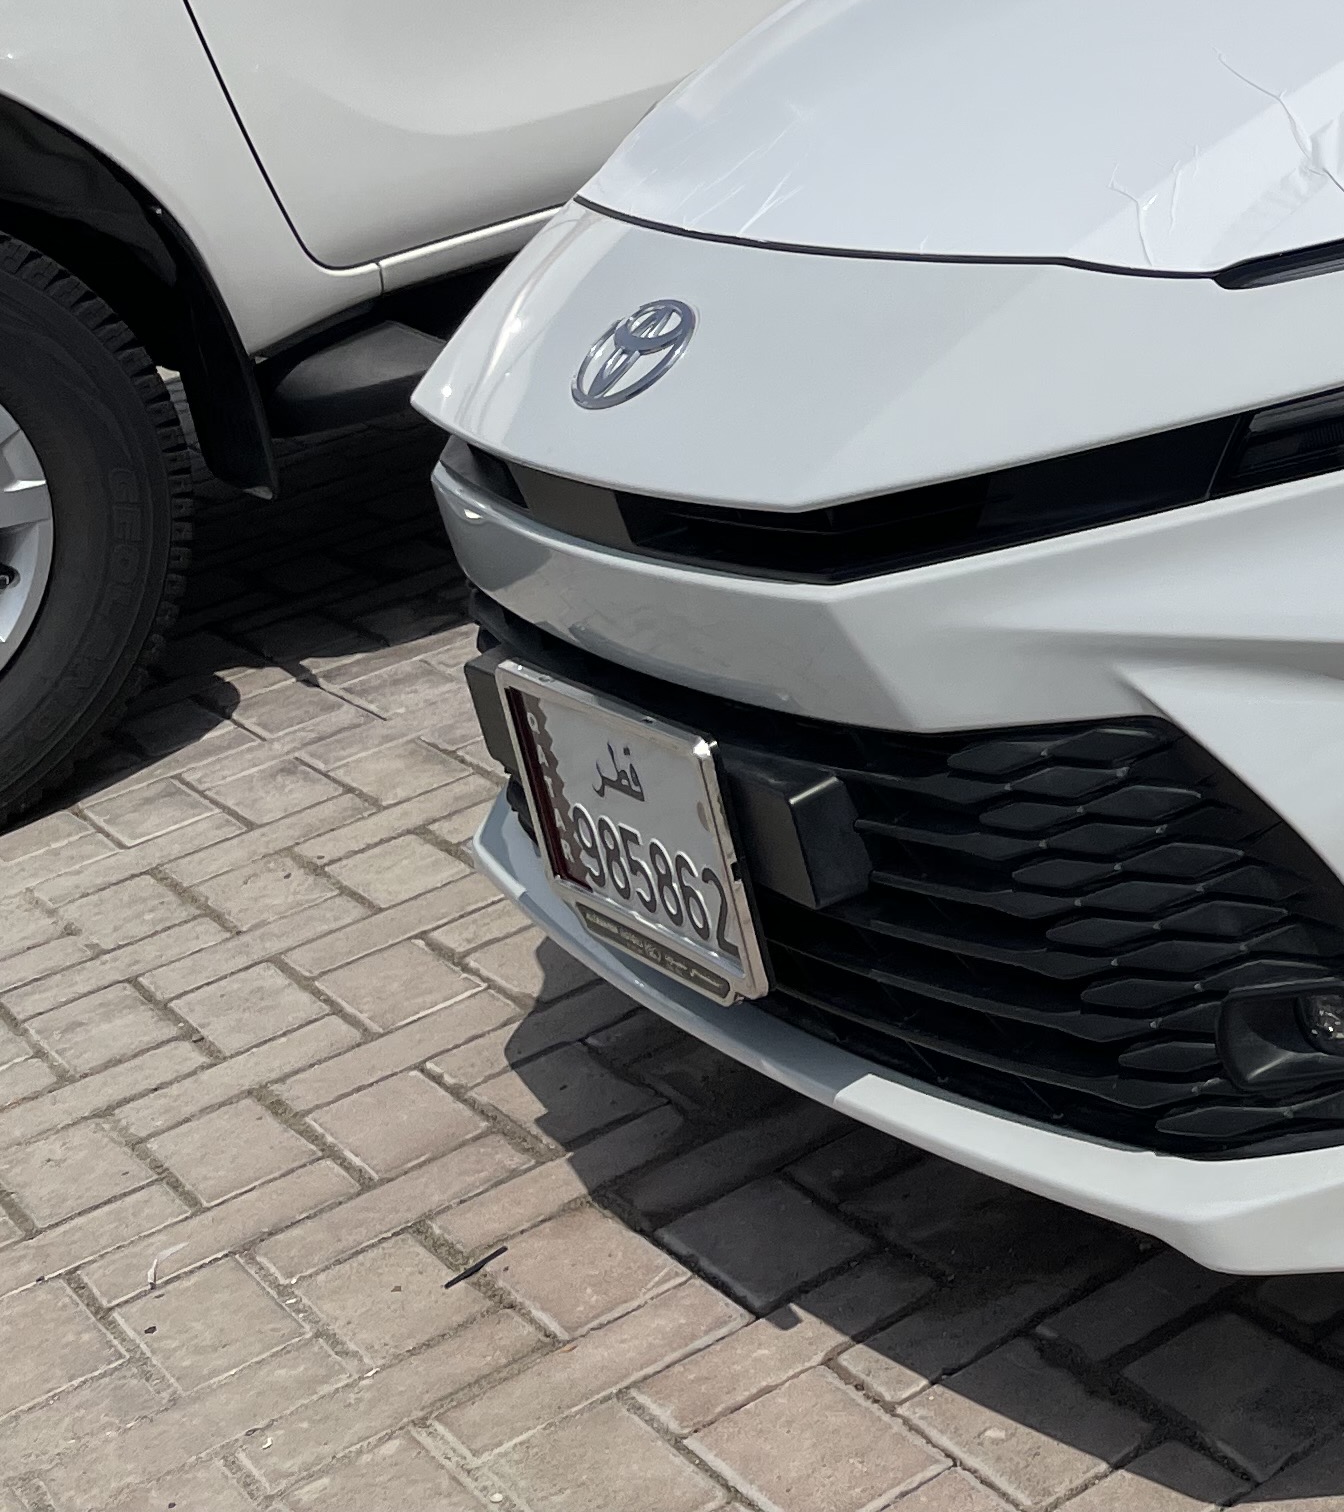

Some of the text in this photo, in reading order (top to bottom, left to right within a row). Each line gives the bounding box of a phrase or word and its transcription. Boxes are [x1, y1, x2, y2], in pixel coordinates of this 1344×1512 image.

[526, 711, 576, 864] QATAR
[591, 741, 645, 803] قطر
[571, 803, 740, 963] 985862
